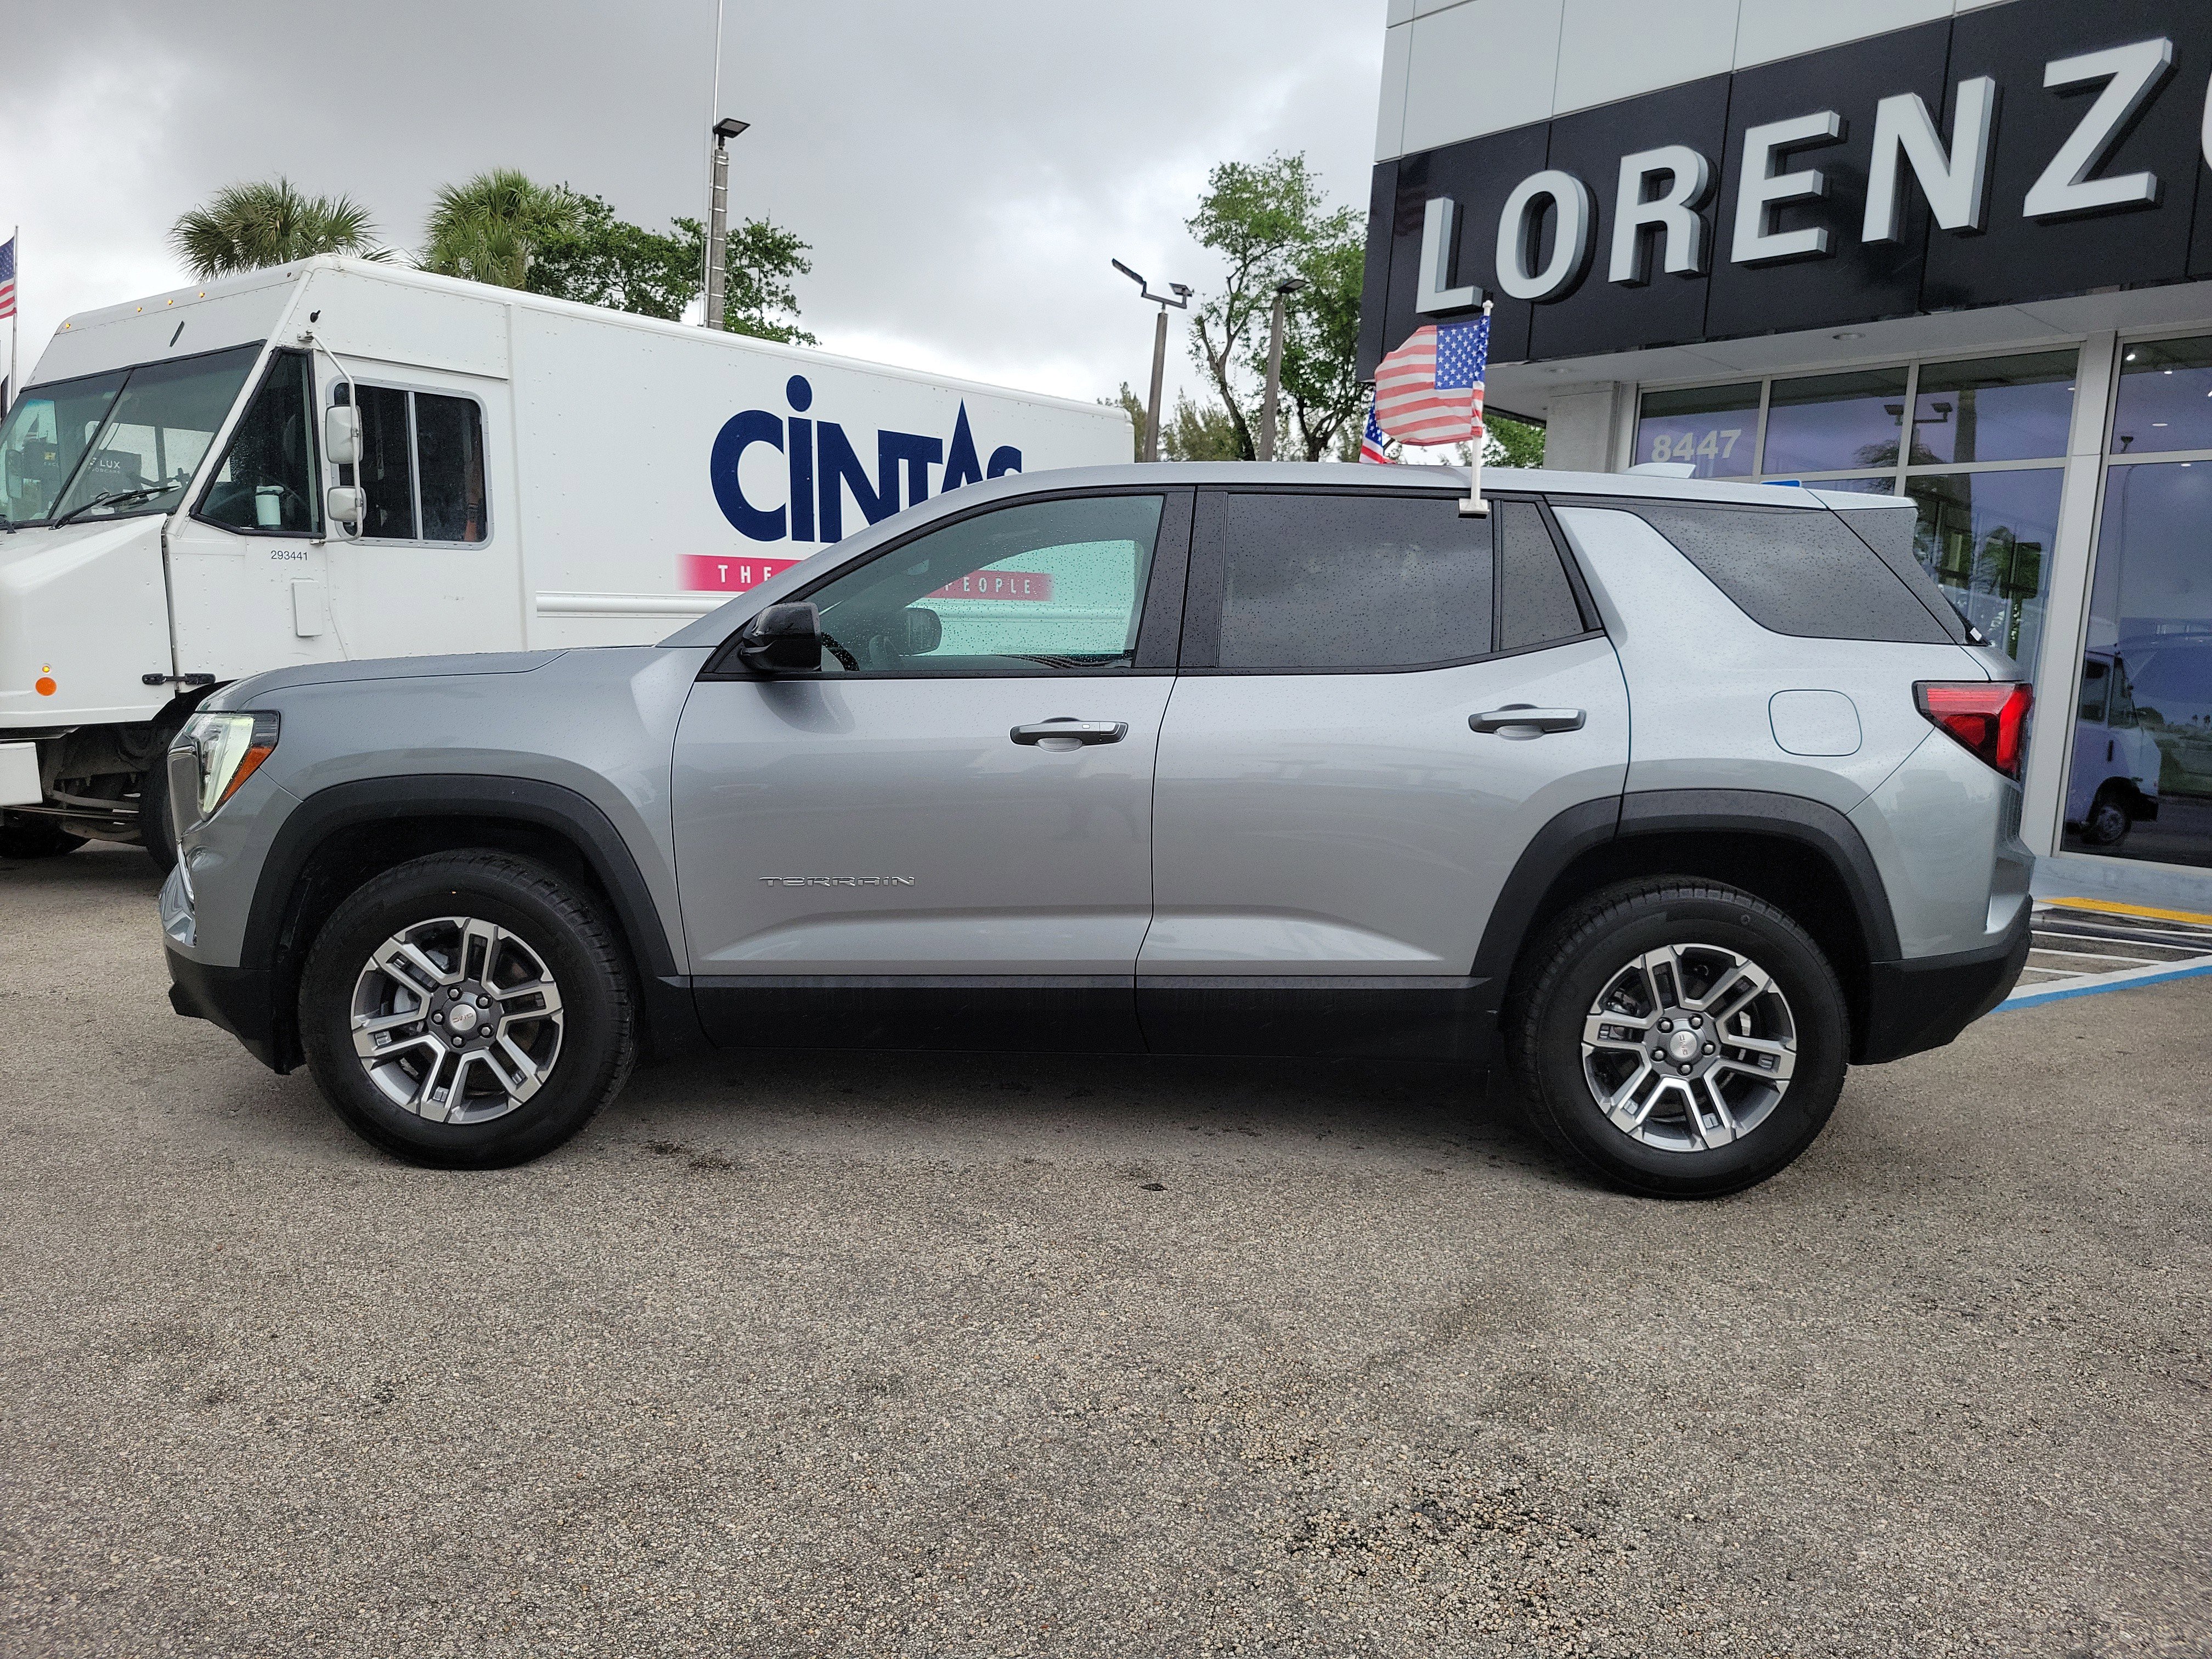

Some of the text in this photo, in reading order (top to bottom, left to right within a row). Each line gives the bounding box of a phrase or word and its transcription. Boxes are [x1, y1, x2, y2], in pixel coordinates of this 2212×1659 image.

[1415, 36, 2212, 313] LORENZ
[1651, 428, 1742, 462] 8447
[100, 460, 120, 469] LUX
[270, 550, 308, 561] 293441
[759, 876, 915, 887] TERRAIN
